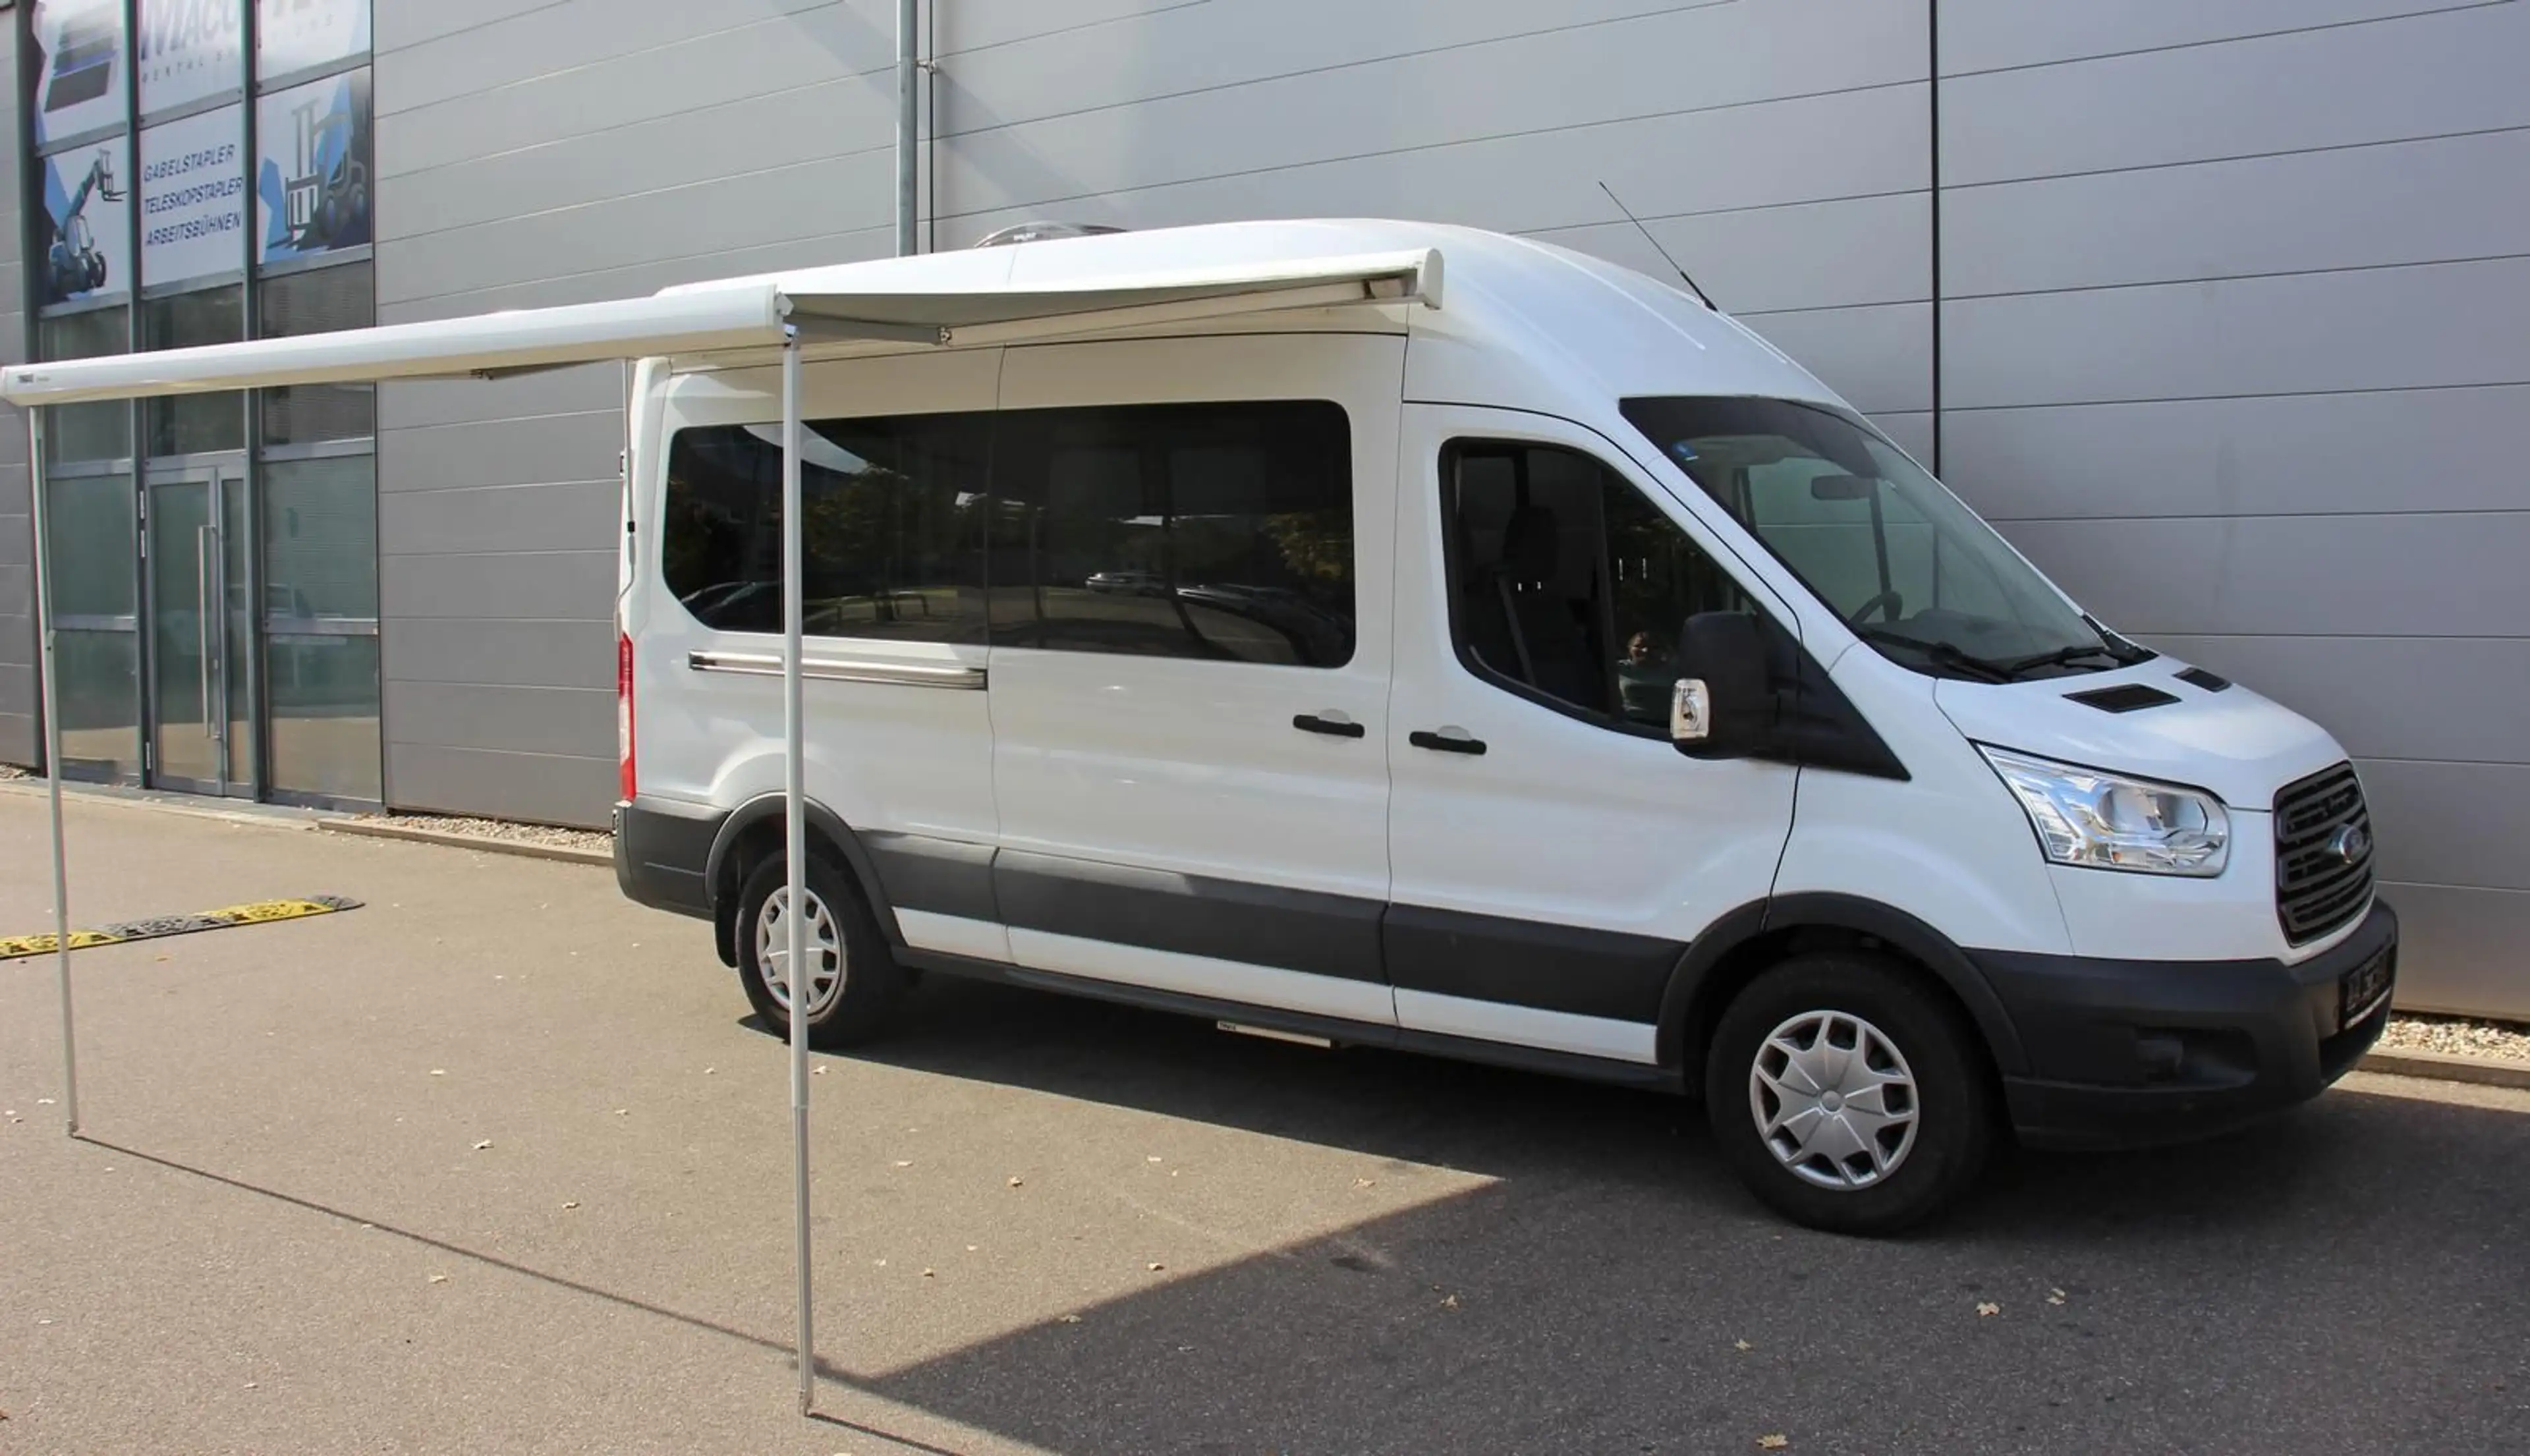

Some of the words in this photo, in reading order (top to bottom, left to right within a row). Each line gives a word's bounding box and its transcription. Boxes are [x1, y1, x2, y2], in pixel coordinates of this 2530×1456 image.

[144, 144, 235, 182] GABELSTAPLER
[145, 177, 242, 215] TELESKOPSTAPLER
[145, 211, 241, 246] ARBEITSBÜHNEN
